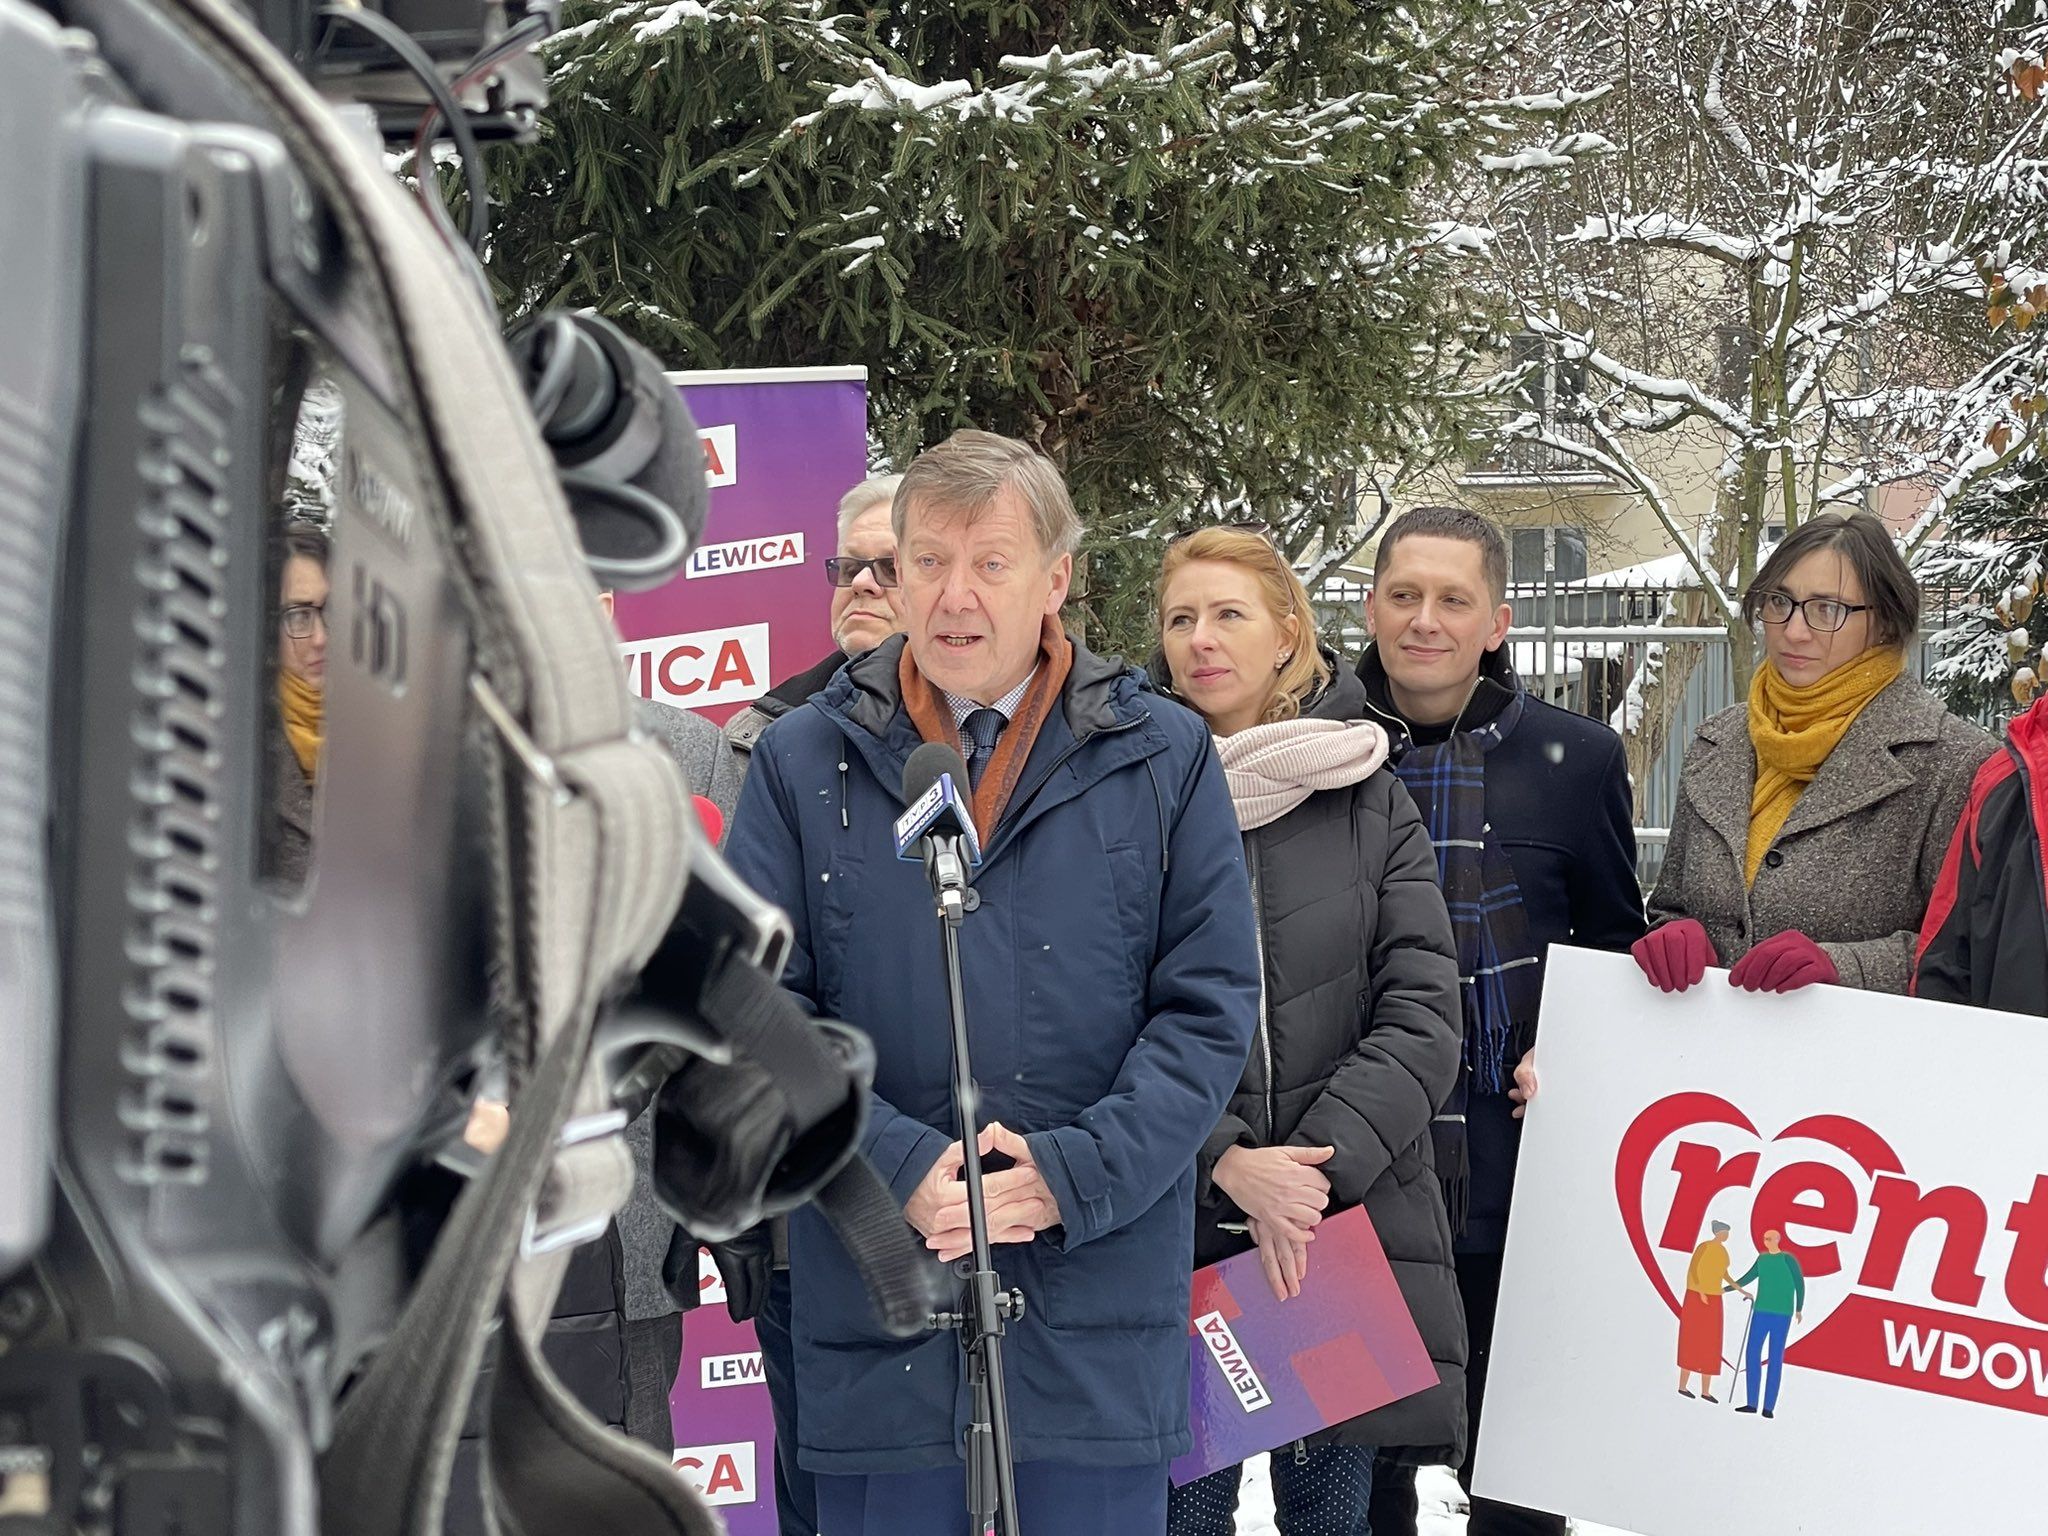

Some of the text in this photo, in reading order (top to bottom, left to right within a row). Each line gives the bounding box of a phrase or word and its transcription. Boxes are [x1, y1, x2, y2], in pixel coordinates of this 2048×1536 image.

[694, 539, 798, 572] LEWICA
[623, 639, 756, 699] ICA
[709, 1357, 764, 1381] LEW
[1204, 1317, 1263, 1405] LEWICA
